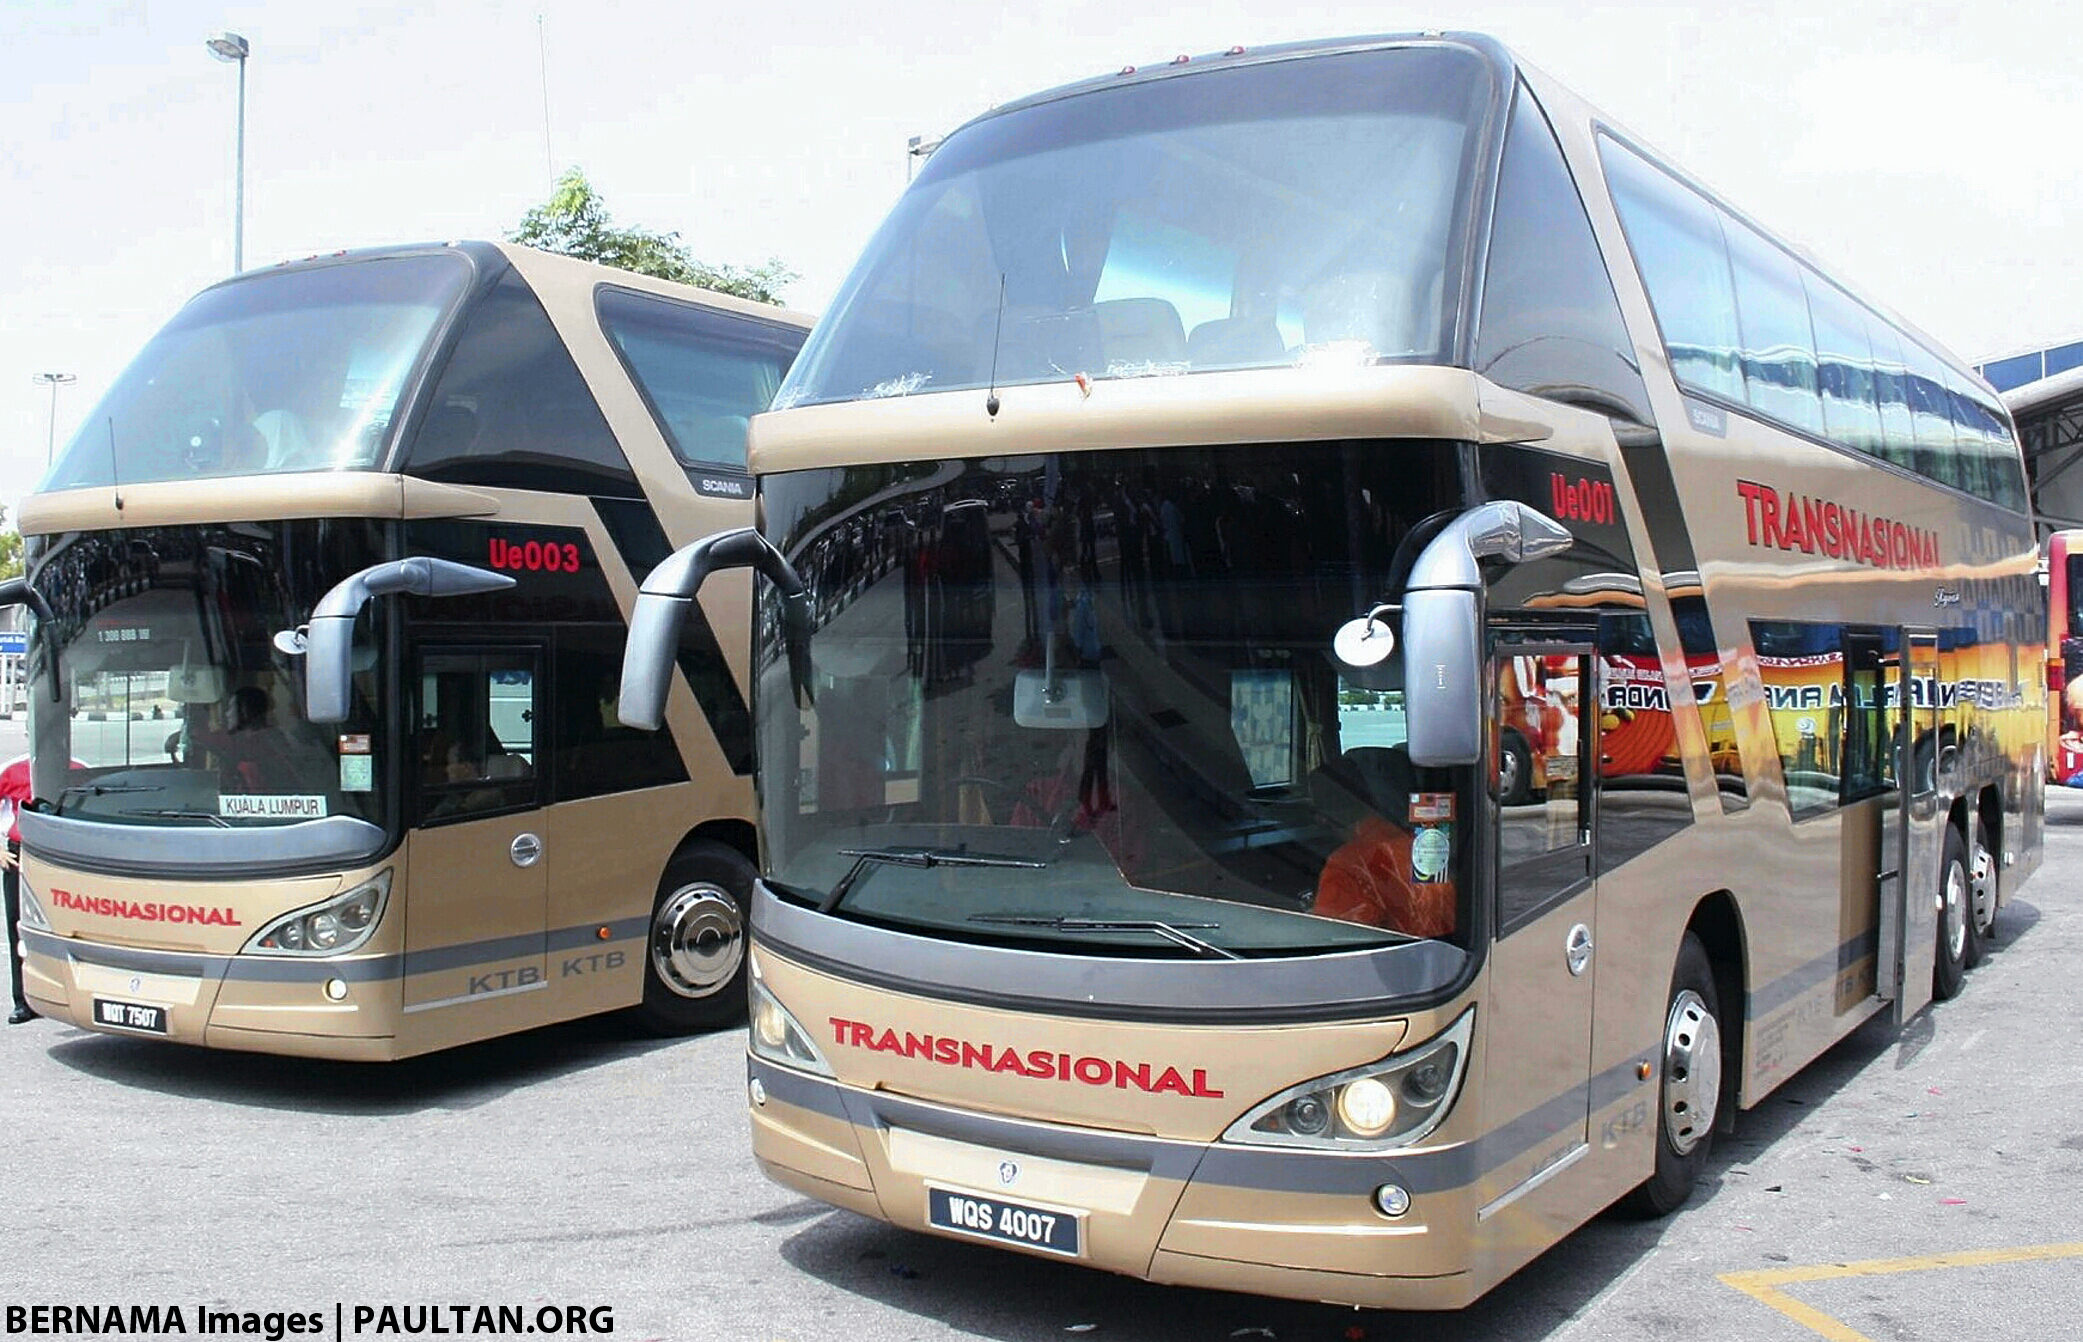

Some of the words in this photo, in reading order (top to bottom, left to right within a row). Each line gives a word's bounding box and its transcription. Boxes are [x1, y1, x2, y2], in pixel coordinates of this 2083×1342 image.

[702, 479, 743, 495] SCANIA
[1736, 479, 1940, 570] TRANSNASIONAL
[226, 799, 266, 815] KUALA
[269, 799, 320, 816] LUMPUR
[51, 888, 242, 927] TRANSNASIONAL
[562, 951, 625, 977] KTB
[469, 966, 540, 995] KTB
[126, 1004, 158, 1028] 7507
[829, 1017, 1225, 1099] TRANSNASIONAL
[949, 1197, 994, 1231] WQS
[998, 1210, 1056, 1243] 4007
